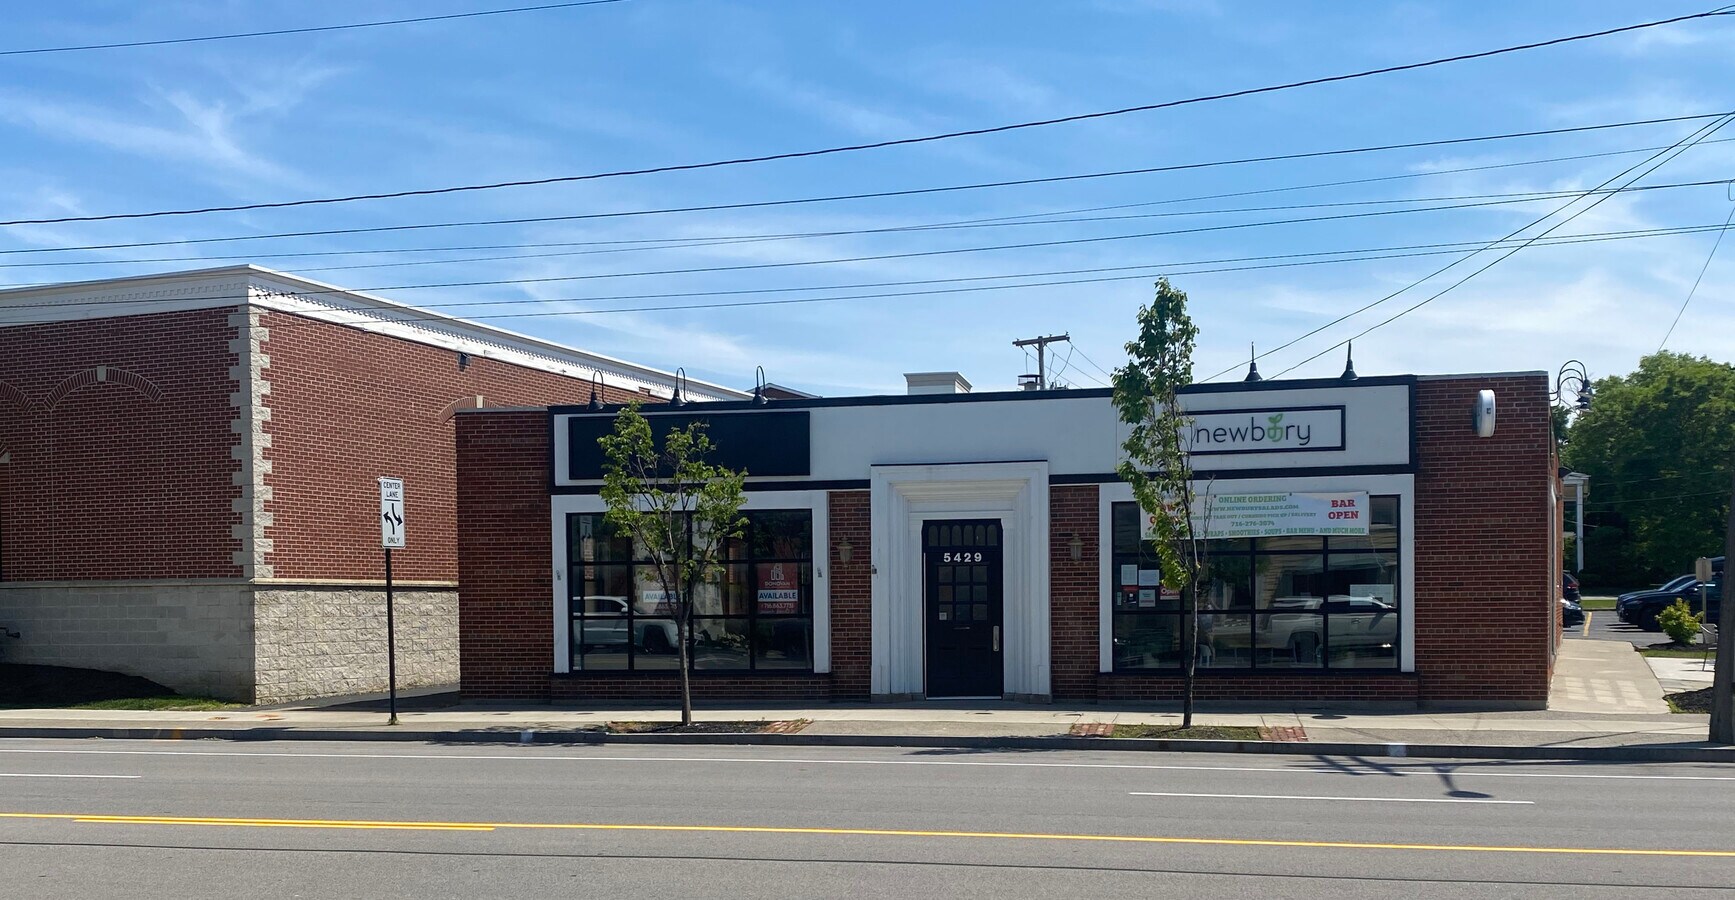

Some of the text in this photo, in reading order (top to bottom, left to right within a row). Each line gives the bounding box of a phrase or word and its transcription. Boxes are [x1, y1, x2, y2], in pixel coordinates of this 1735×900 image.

[1196, 414, 1311, 446] newbury
[383, 481, 401, 490] CENTER
[386, 491, 399, 499] LANE
[1219, 495, 1287, 504] ONLINE ORDERING
[1331, 499, 1356, 508] BAR
[1328, 510, 1360, 520] OPEN
[943, 552, 983, 563] 5429
[645, 592, 681, 600] AVAILBL
